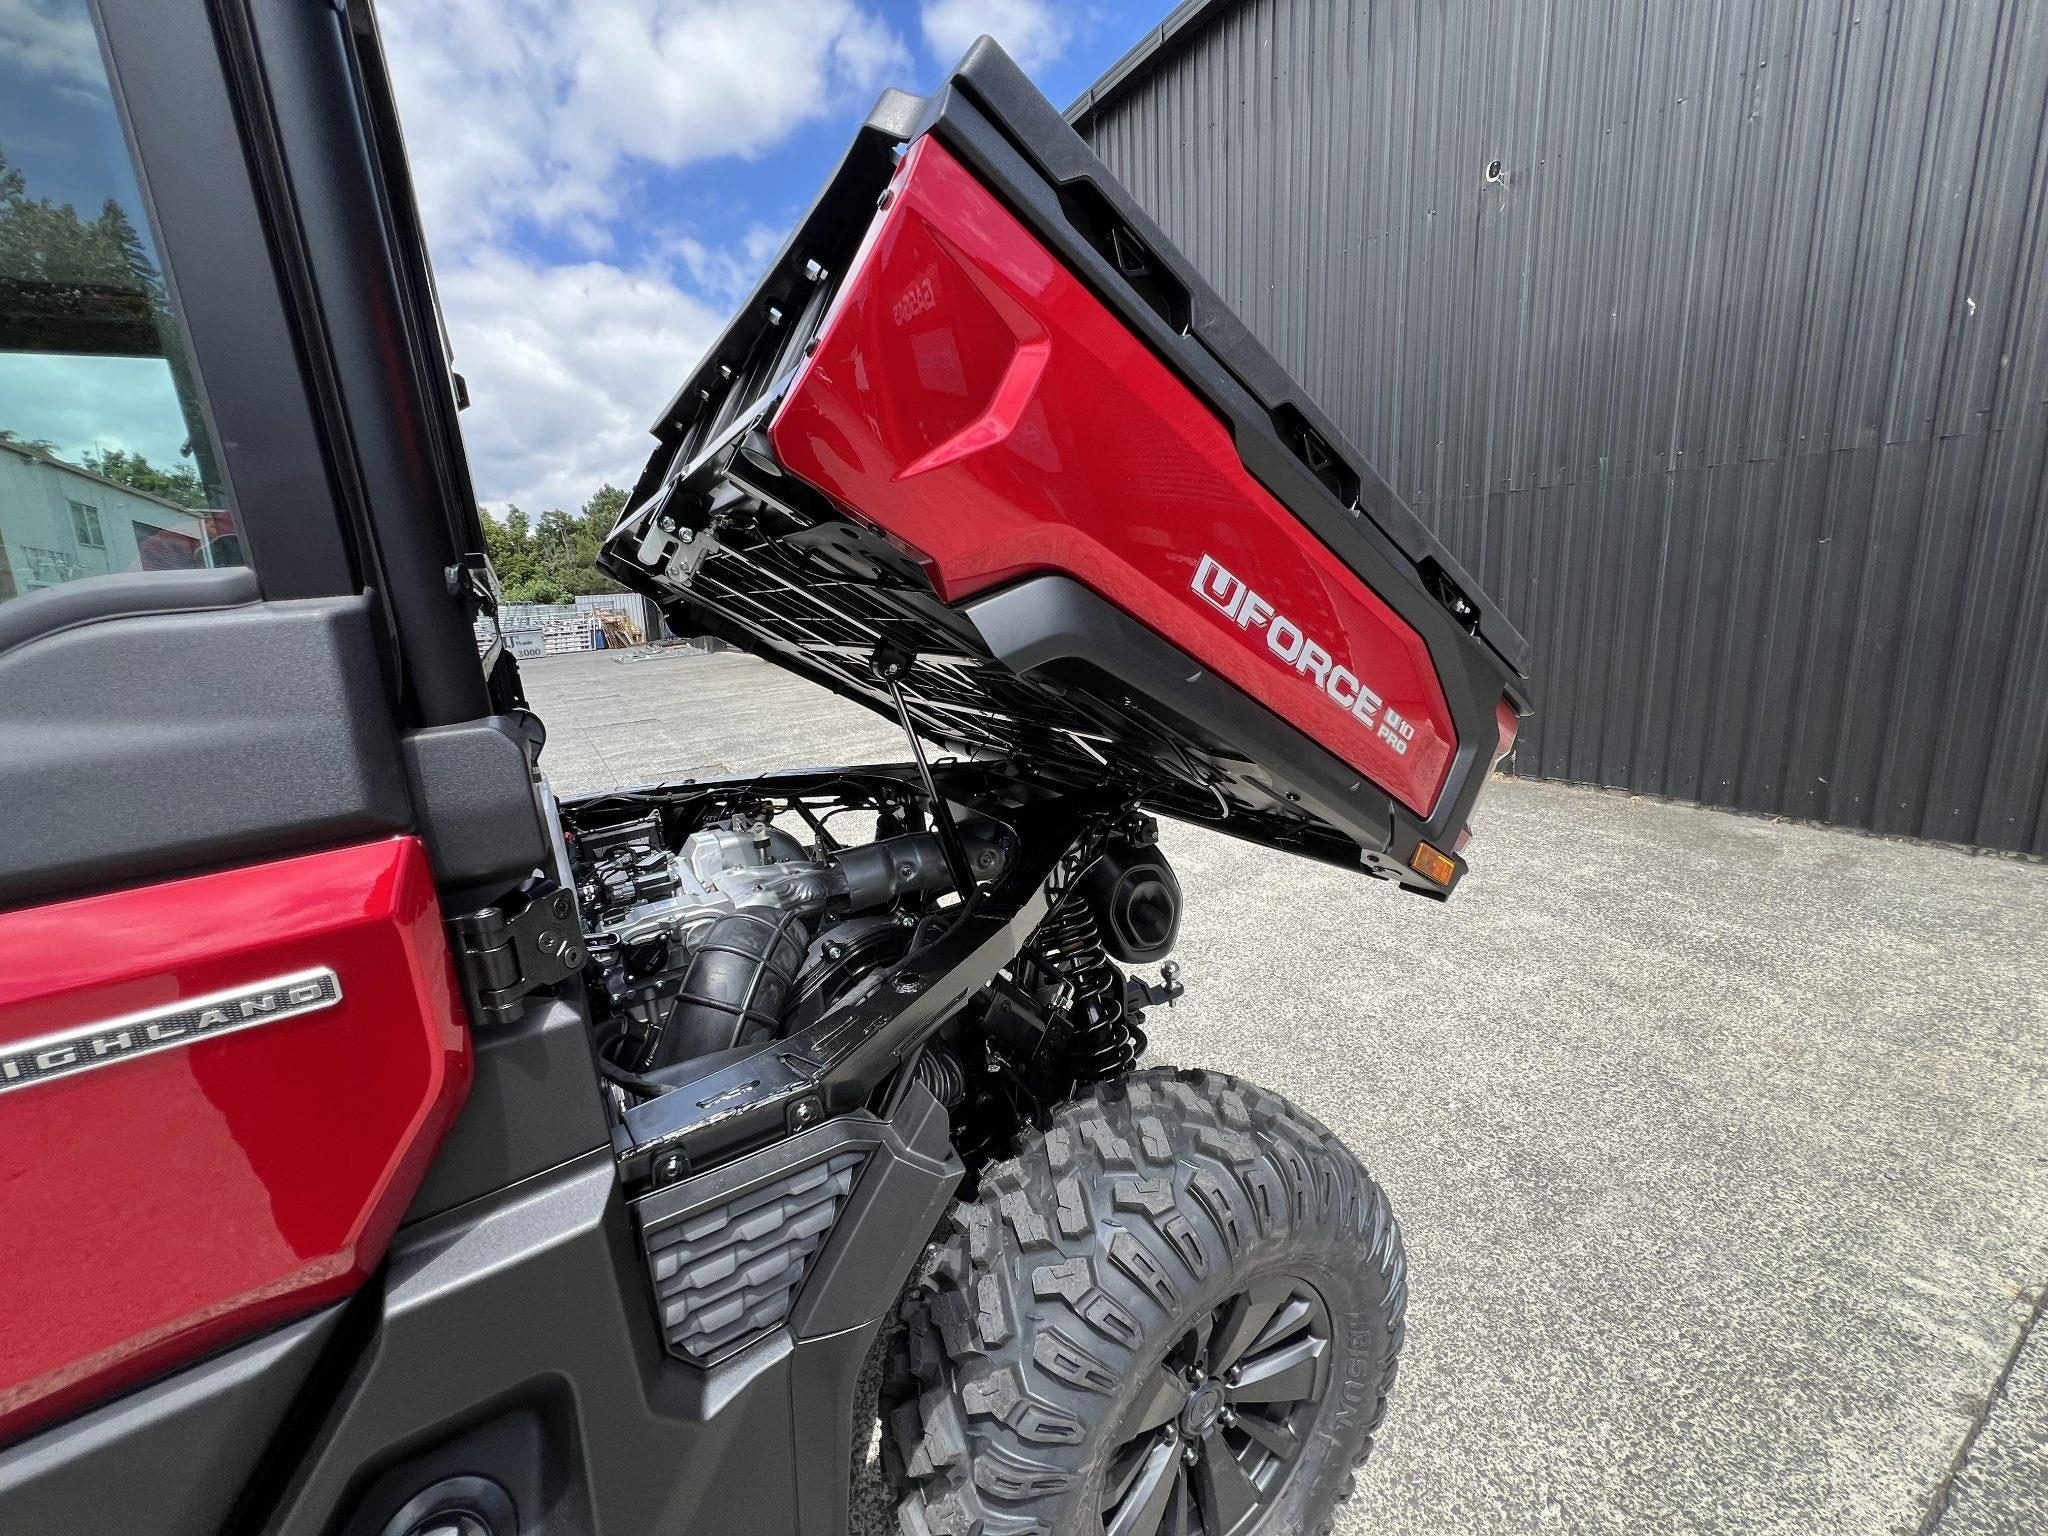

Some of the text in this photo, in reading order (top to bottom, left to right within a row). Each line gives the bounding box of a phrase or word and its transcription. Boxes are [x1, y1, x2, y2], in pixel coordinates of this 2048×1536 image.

[518, 648, 541, 658] 3000
[1377, 723, 1408, 756] PRO
[1383, 707, 1415, 741] U10
